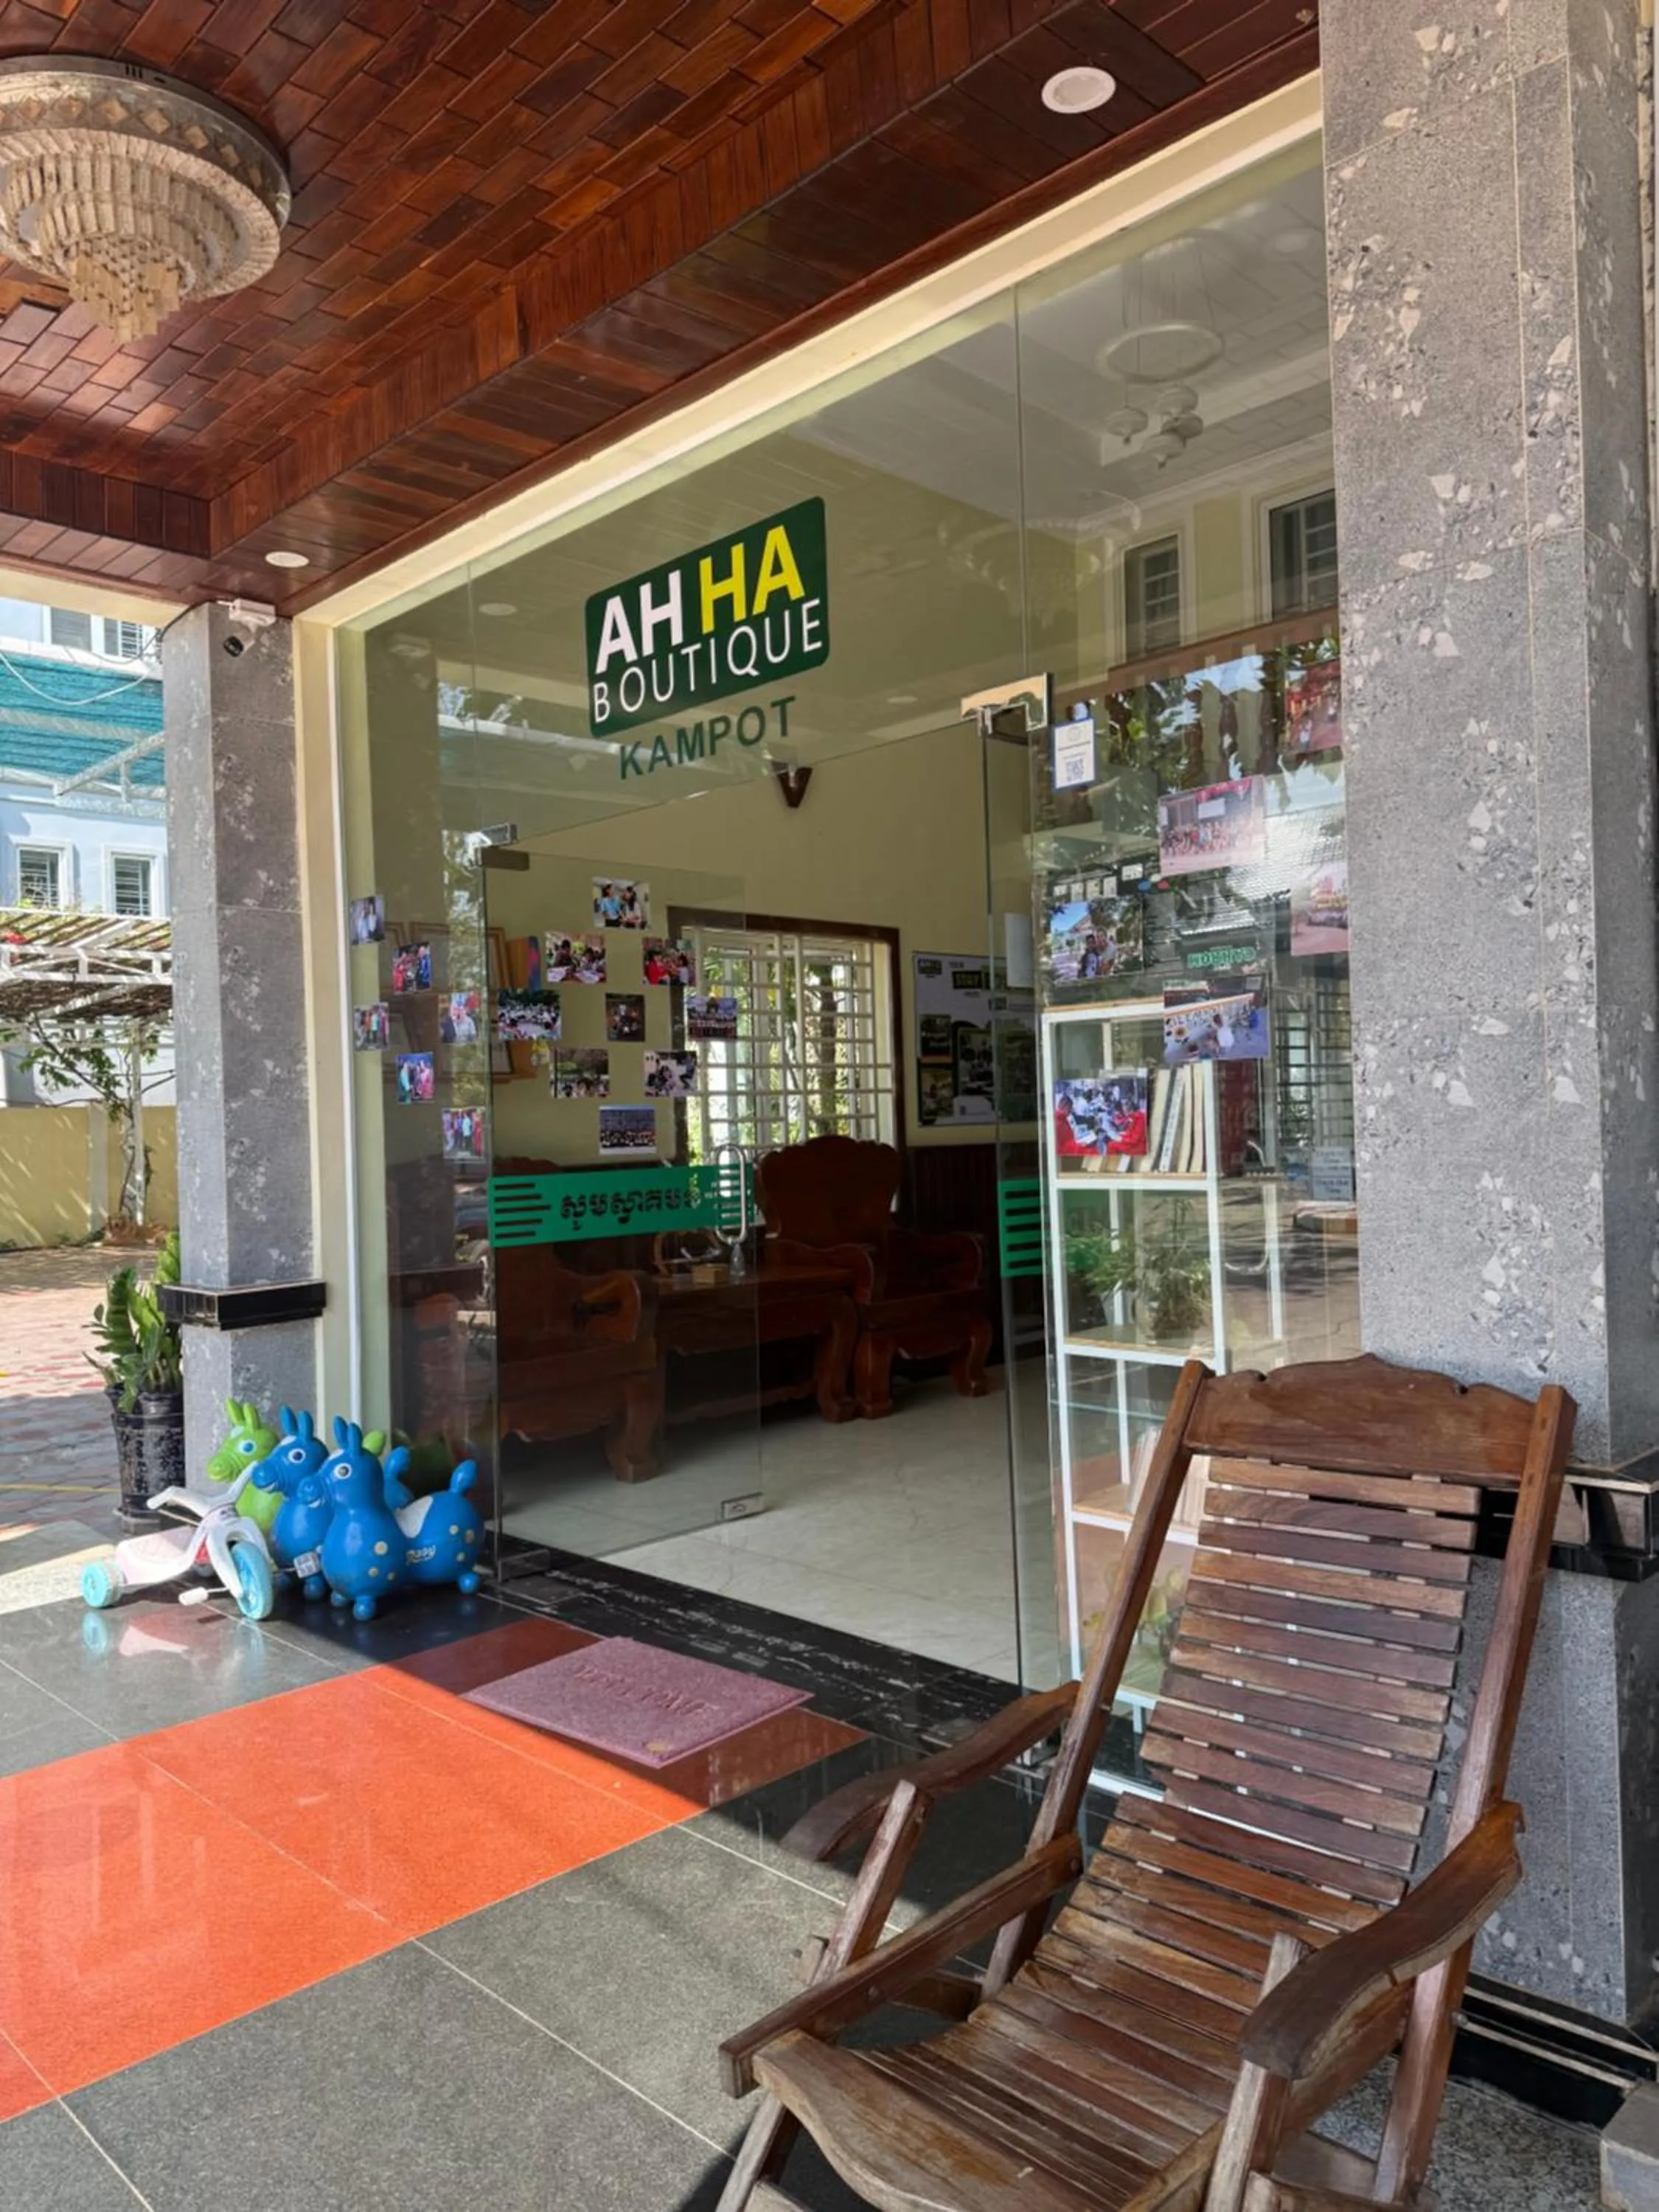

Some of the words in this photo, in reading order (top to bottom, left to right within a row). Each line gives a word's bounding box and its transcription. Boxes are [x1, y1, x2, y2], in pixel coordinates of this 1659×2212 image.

[595, 569, 684, 675] AH
[699, 524, 805, 636] HA
[593, 598, 823, 724] BOUTIQUE
[619, 695, 796, 780] KAMPOT
[560, 1186, 701, 1231] សូមស្វាគមន
